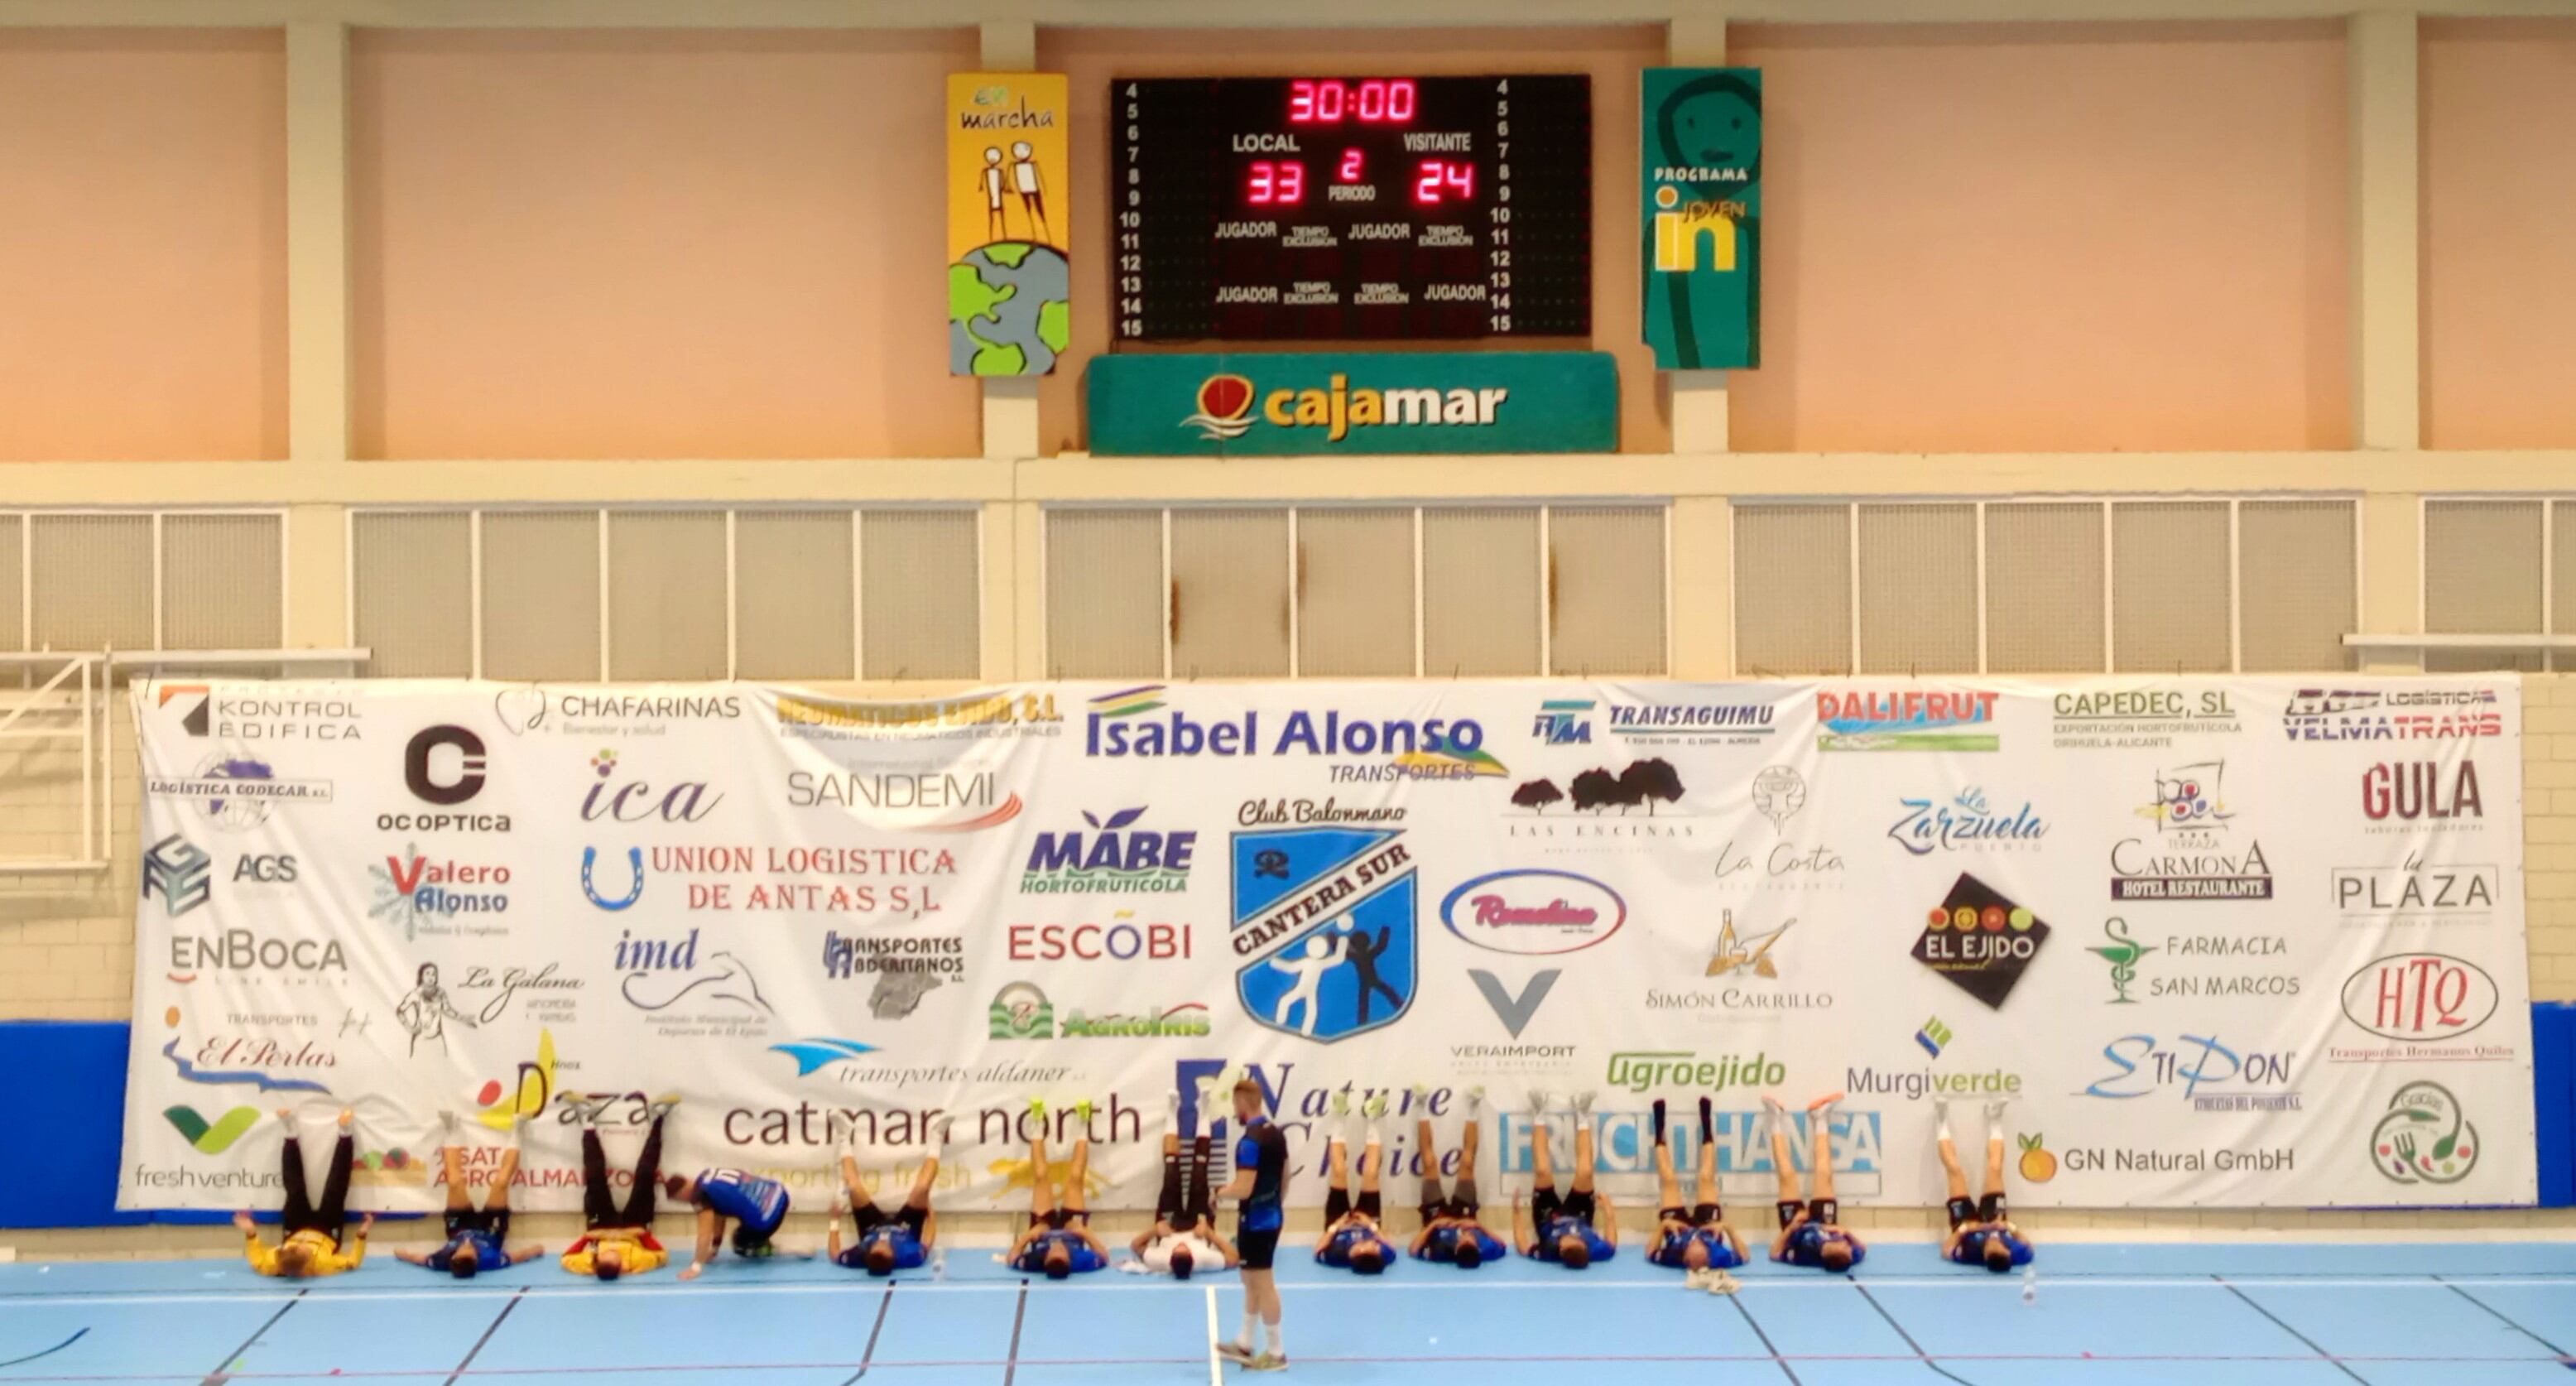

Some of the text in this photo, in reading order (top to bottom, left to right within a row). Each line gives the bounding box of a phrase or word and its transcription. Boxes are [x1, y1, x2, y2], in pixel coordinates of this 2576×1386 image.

[1126, 84, 1138, 99] 4
[1497, 79, 1508, 94] 4
[1290, 79, 1415, 123] 30:00
[1497, 100, 1508, 116] 5
[961, 95, 1054, 130] marcha
[1127, 104, 1139, 120] 5
[1127, 125, 1139, 141] 6
[1497, 122, 1509, 137] 6
[1233, 134, 1300, 152] LOCAL
[1404, 132, 1471, 152] VISITANTE
[1498, 142, 1509, 158] 7
[1127, 147, 1139, 162] 7
[1341, 150, 1364, 180] 2
[1498, 164, 1510, 180] 8
[1127, 169, 1140, 184] 8
[1247, 161, 1305, 204] 33
[1416, 161, 1473, 202] 24
[1654, 167, 1748, 182] PROGRAMA
[1128, 190, 1141, 206] 9
[1329, 185, 1376, 201] PERIODO
[1499, 185, 1511, 202] 9
[1119, 212, 1141, 228] 10
[1490, 208, 1511, 224] 10
[1214, 221, 1277, 238] JUGADOR
[1292, 226, 1329, 238] TIEMPO
[1348, 223, 1411, 240] JUGADOR
[1426, 225, 1464, 237] TIEMPO
[1490, 229, 1510, 245] 11
[1120, 233, 1140, 249] 11
[1120, 255, 1141, 271] 12
[1490, 251, 1511, 267] 12
[1121, 277, 1141, 292] 13
[1294, 282, 1331, 293] TIEMPO
[1361, 283, 1399, 294] TIEMPO
[1490, 272, 1511, 288] 13
[1216, 286, 1278, 304] JUGADOR
[1424, 284, 1486, 301] JUGADOR
[1121, 298, 1141, 314] 14
[1490, 294, 1511, 310] 14
[1121, 320, 1142, 335] 15
[1490, 315, 1511, 331] 15
[1264, 373, 1508, 441] cajamar
[219, 700, 363, 719] KONTROL
[561, 695, 741, 719] CHAFARINAS
[1816, 691, 2001, 723] DALIFRUT
[2054, 691, 2236, 719] CAPEDEC, SL
[1609, 705, 1775, 726] TRANSAGUIMU
[219, 723, 363, 741] EDIFICA
[1086, 710, 1483, 757] Isabel Alonso
[2283, 713, 2502, 741] VELMATRANS
[1329, 763, 1476, 783] TRANSPORTES
[787, 771, 994, 808] SANDEMI
[2362, 759, 2483, 821] GULA
[1238, 796, 1408, 826] Club Balonmano
[377, 814, 411, 831] OC
[1510, 825, 1693, 837] LAS ENCINAS
[1887, 796, 2051, 856] Zarzuela
[651, 846, 958, 875] UNION LOGISTICA
[1714, 840, 1846, 878] La Costa
[233, 854, 299, 883] AGS
[387, 855, 511, 895] Valero
[689, 883, 731, 910] DE
[747, 884, 877, 912] ANTAS
[2122, 879, 2266, 898] HOTEL RESTAURANTE
[2338, 874, 2492, 909] PLAZA
[414, 886, 509, 913] Alonso
[1232, 843, 1411, 956] CANTERA SUR
[614, 928, 699, 971] imd
[1926, 935, 2035, 960] EL EJIDO
[2166, 936, 2288, 956] FARMACIA
[458, 965, 495, 989] La
[2150, 975, 2300, 996] SAN MARCOS
[2375, 958, 2469, 1032] HTQ
[226, 1013, 319, 1027] TRANSPORTES
[1450, 1045, 1577, 1059] VERAIMPORT
[2328, 1047, 2401, 1061] Transportes
[840, 1064, 970, 1089] transportes
[1606, 1051, 1786, 1093] agroejido
[1847, 1066, 2022, 1100] Murgiverde
[978, 1092, 1140, 1146] north
[2064, 1148, 2295, 1172] GN Natural GmbH
[136, 1163, 195, 1188] fresh
[895, 1160, 972, 1188] frsh
